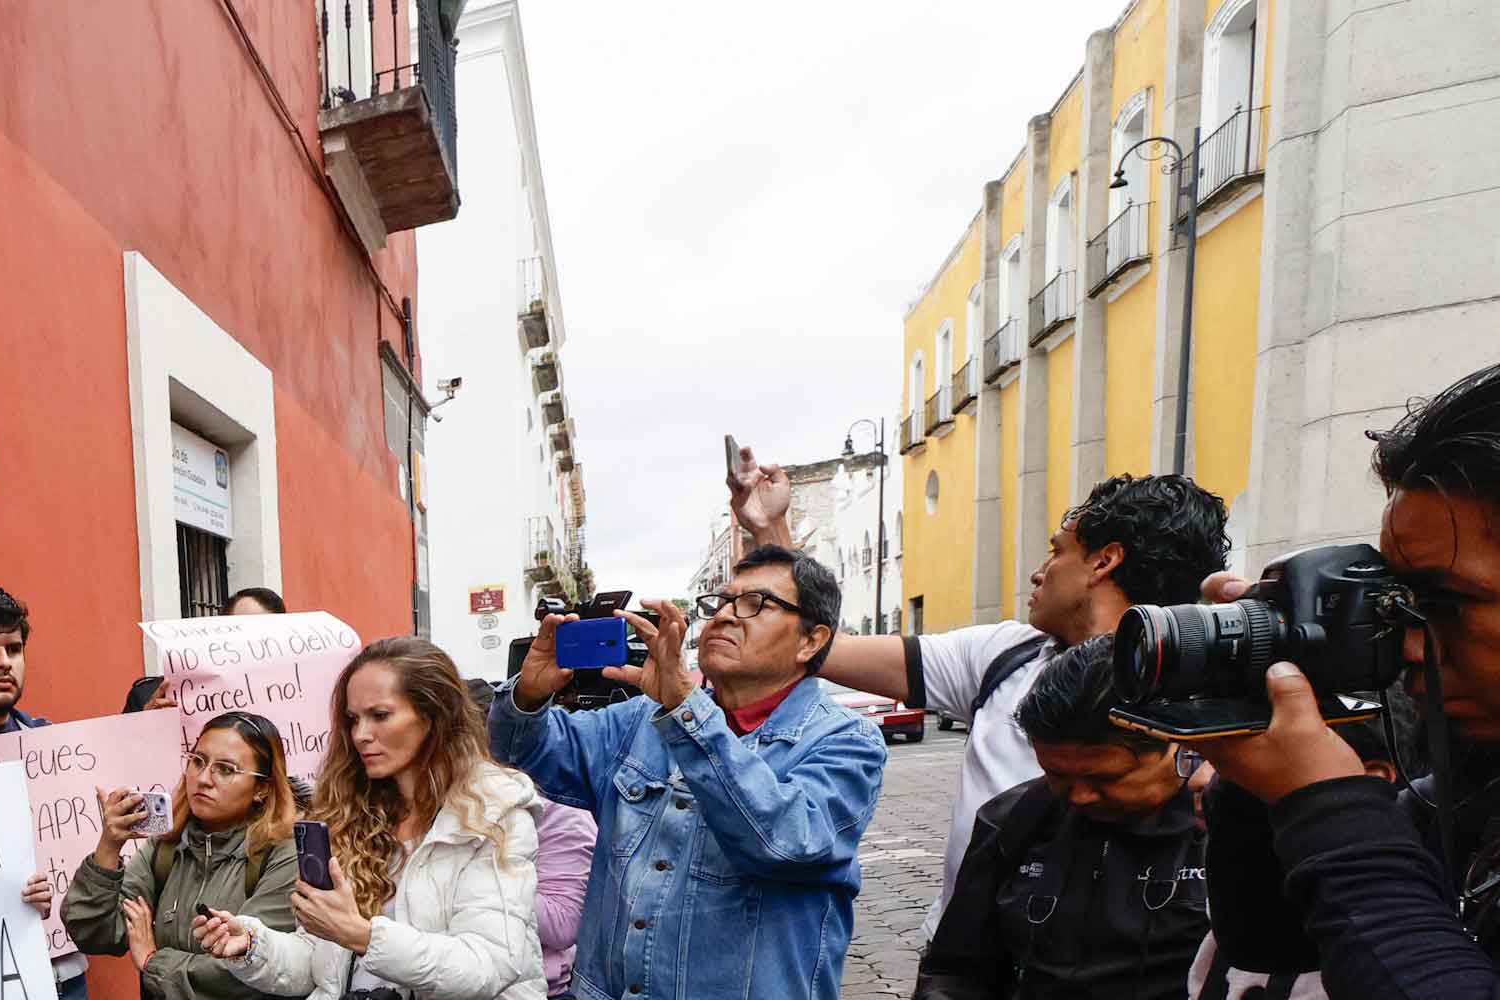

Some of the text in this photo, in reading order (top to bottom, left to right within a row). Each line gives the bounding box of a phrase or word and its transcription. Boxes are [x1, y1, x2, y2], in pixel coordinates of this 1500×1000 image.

[166, 647, 199, 673] no
[208, 641, 241, 666] es
[246, 632, 283, 661] un
[266, 662, 303, 704] no!
